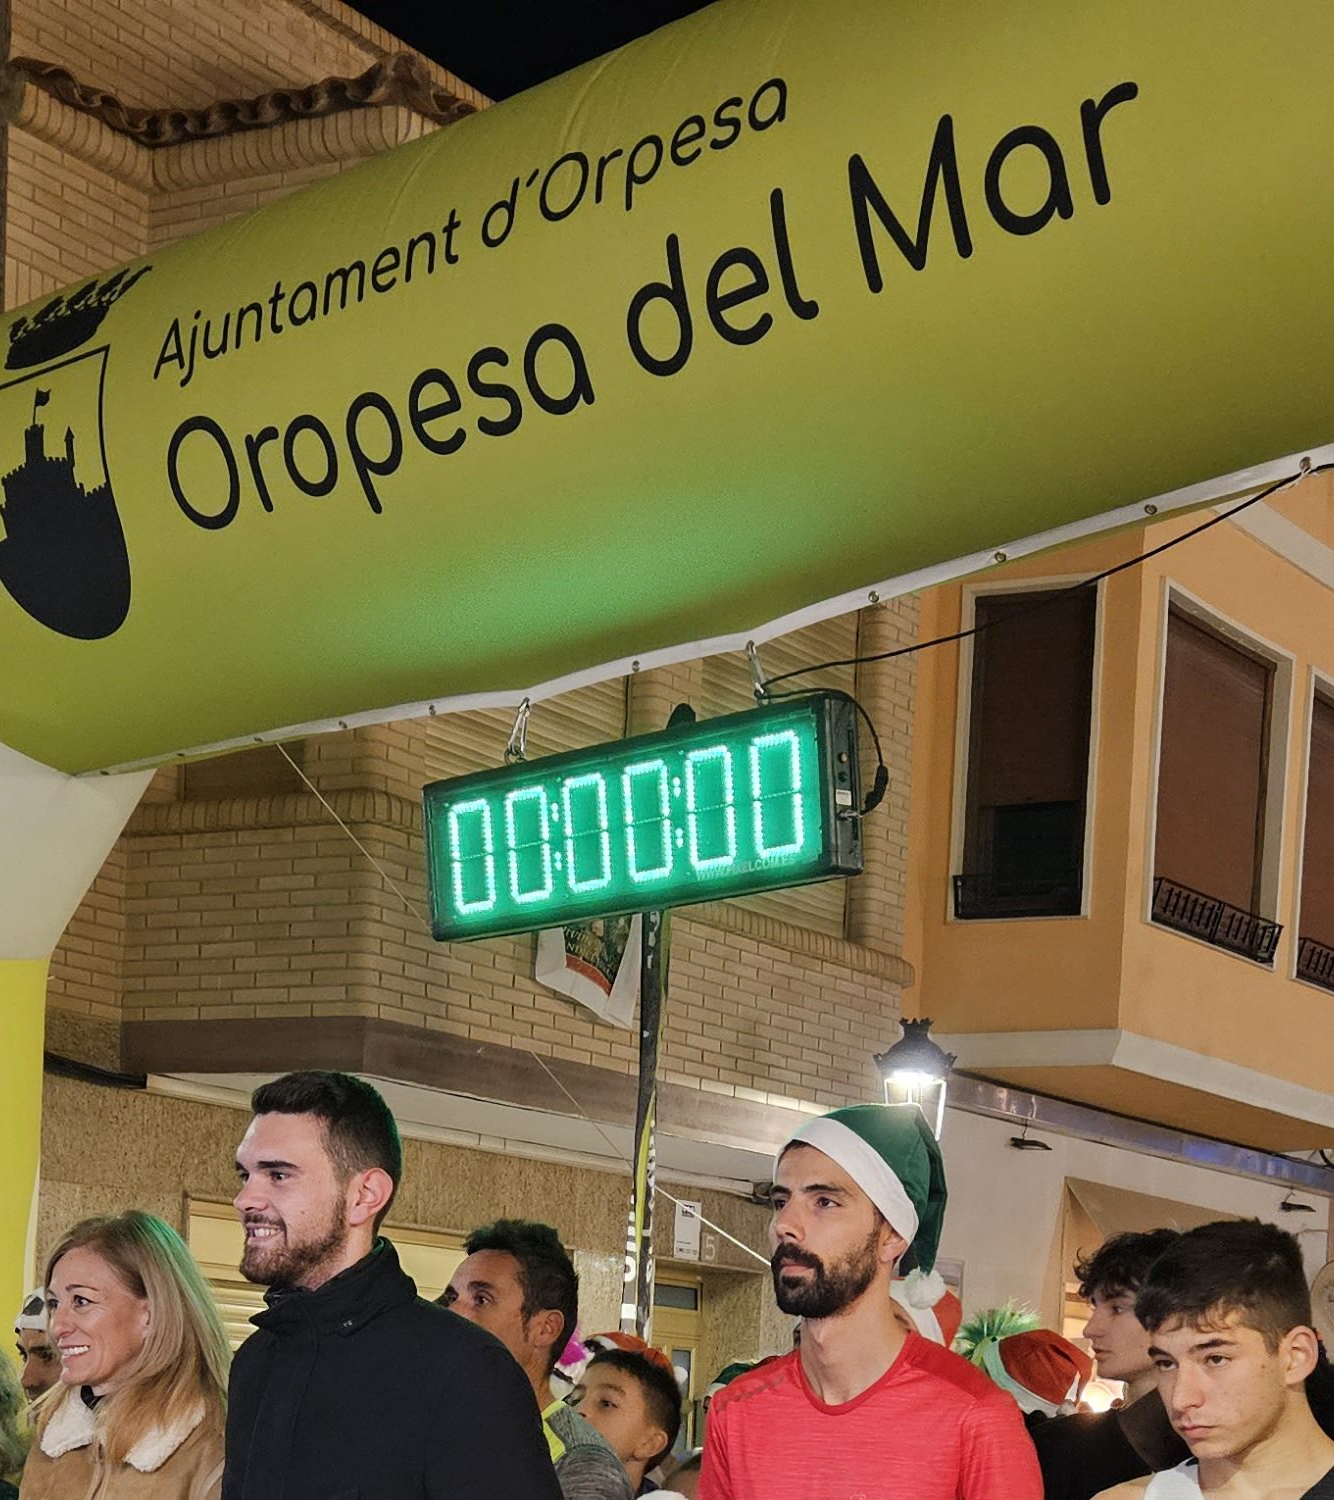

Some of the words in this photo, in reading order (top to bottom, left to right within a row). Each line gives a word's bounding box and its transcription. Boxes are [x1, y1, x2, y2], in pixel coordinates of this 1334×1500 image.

[153, 208, 461, 388] Ajuntament
[167, 322, 596, 530] Oropesa
[626, 187, 820, 377] del
[848, 81, 1139, 293] Mar
[448, 730, 804, 915] 00:00:00
